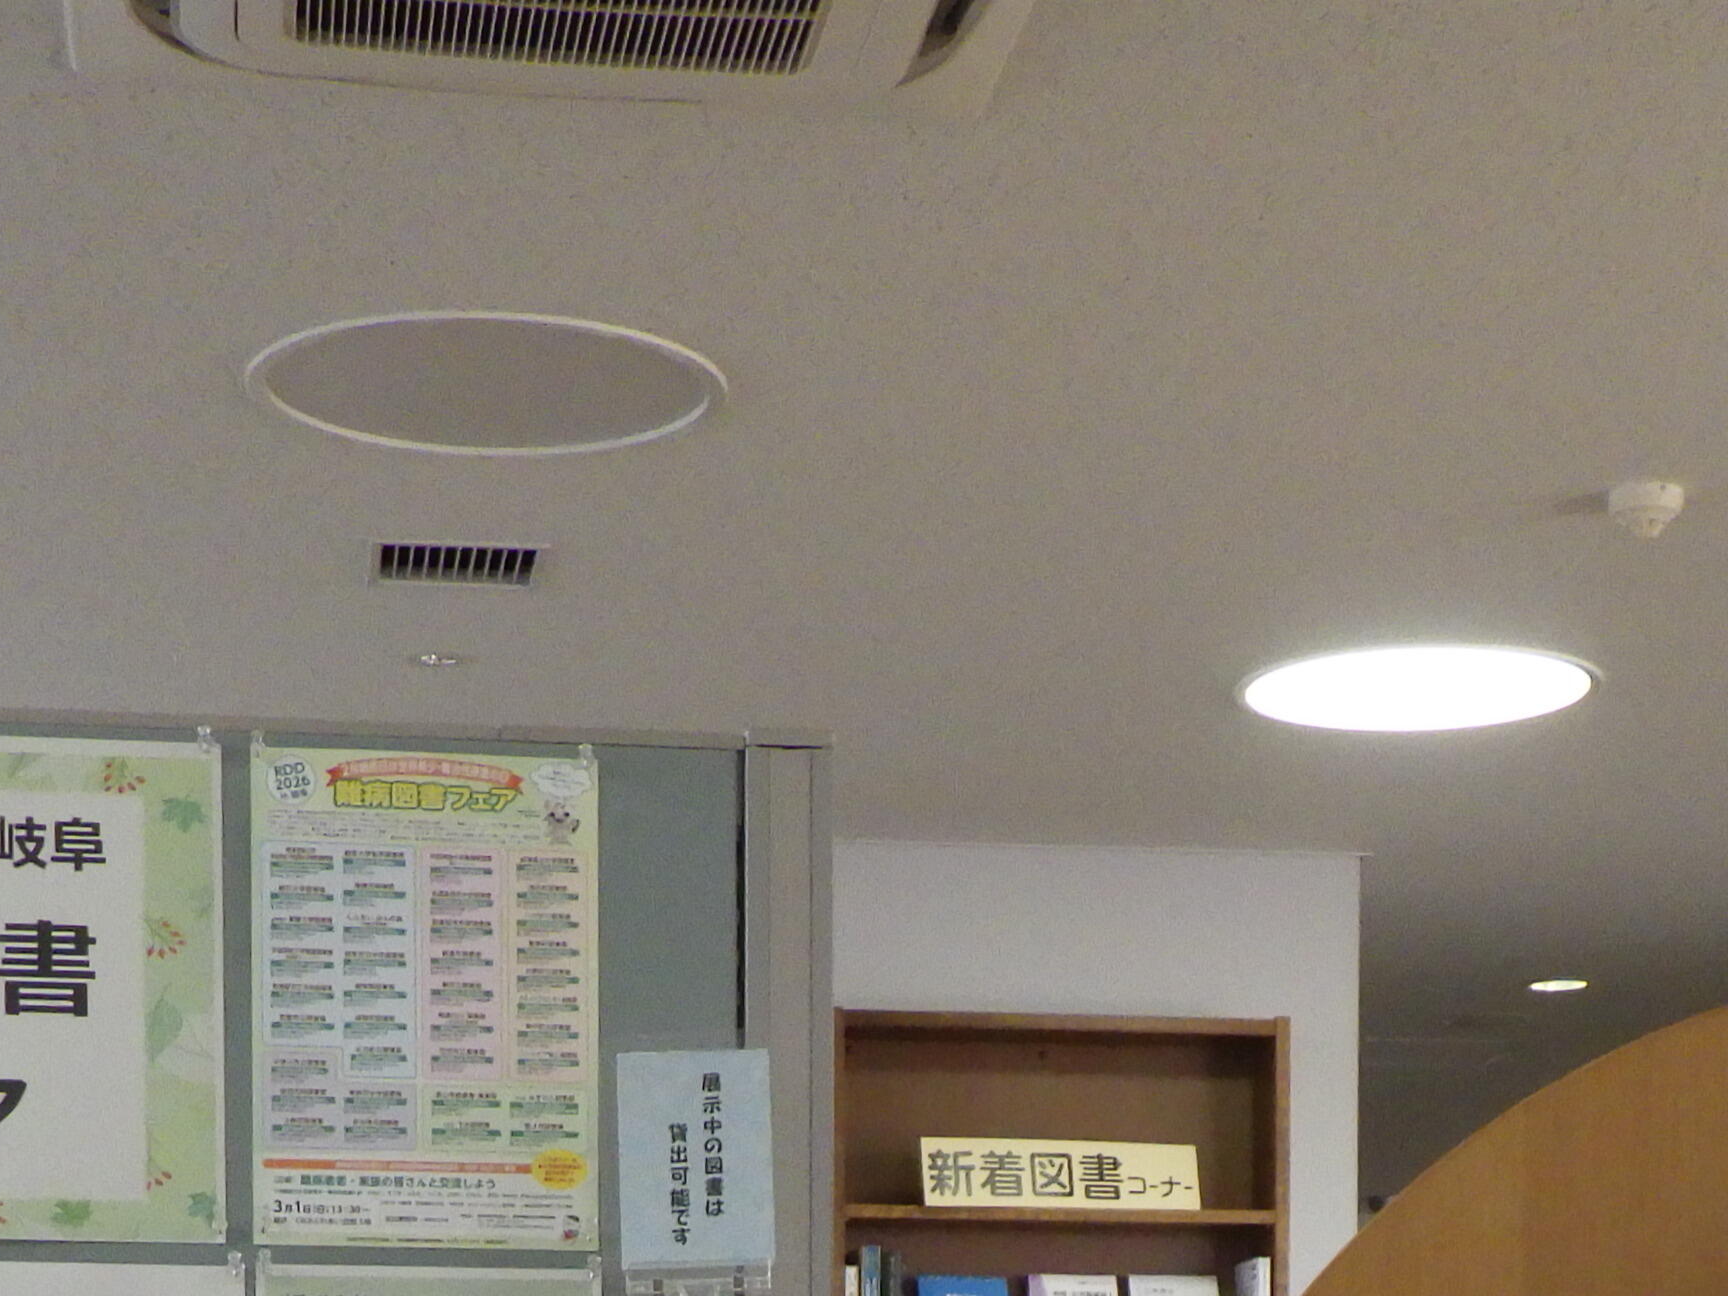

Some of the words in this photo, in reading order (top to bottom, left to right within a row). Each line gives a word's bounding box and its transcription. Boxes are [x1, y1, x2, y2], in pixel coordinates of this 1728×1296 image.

[275, 776, 311, 791] 2026
[667, 1122, 692, 1247] 貸出可能です
[701, 1072, 726, 1218] 展示中の図書は
[927, 1147, 1194, 1201] 新着図書コーナー
